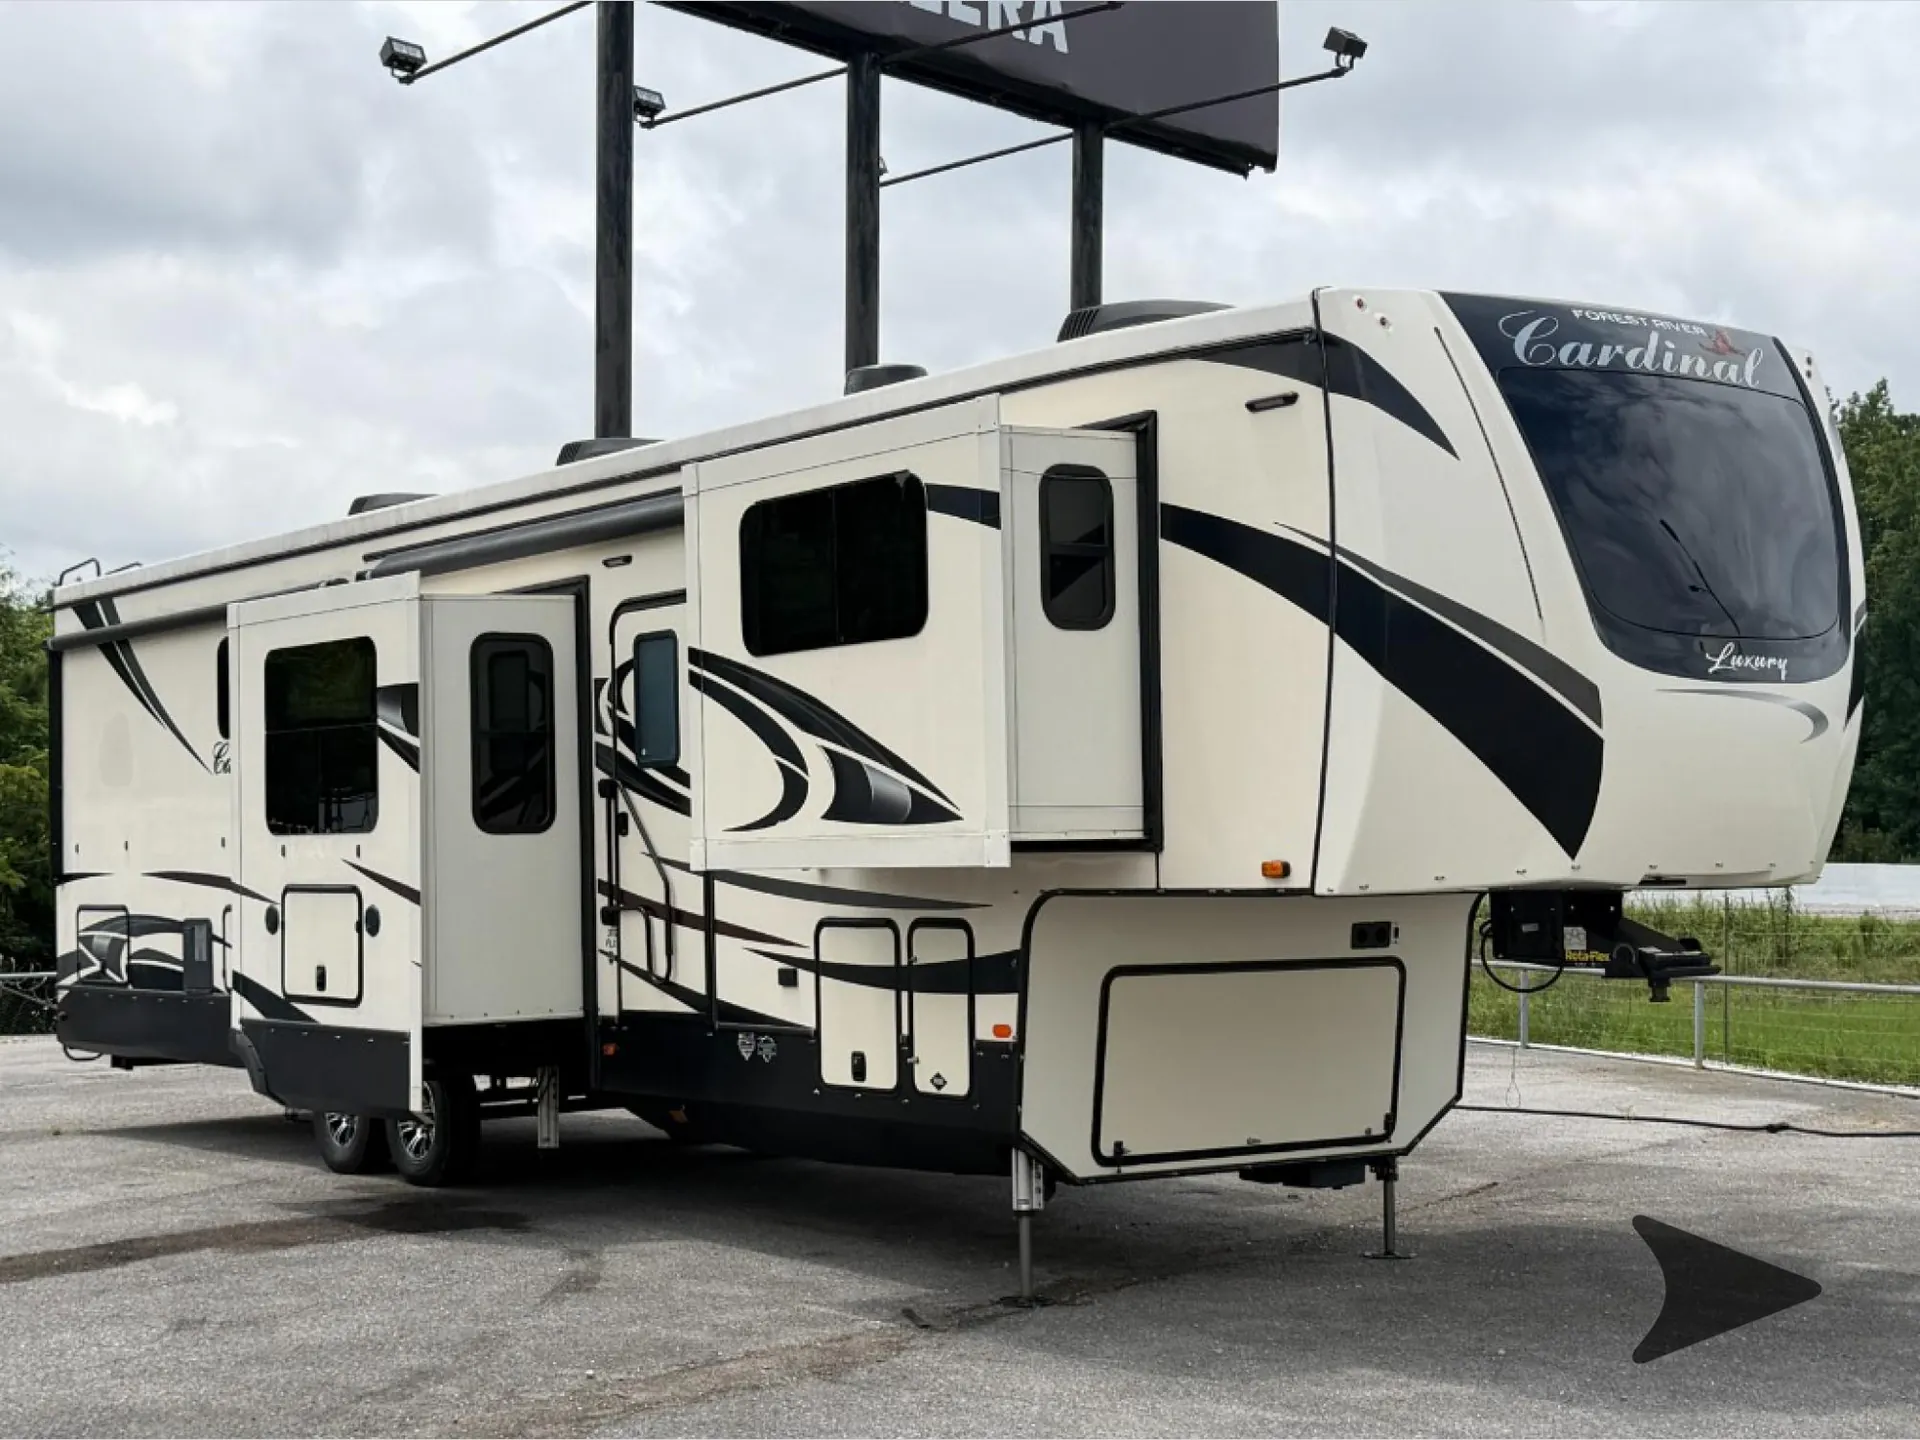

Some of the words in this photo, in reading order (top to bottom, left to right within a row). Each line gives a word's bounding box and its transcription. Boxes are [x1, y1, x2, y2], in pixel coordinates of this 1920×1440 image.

[1571, 308, 1647, 327] FOREST
[1651, 318, 1708, 337] RIVER
[1498, 309, 1764, 388] Cardinal
[1705, 641, 1788, 681] Luxury
